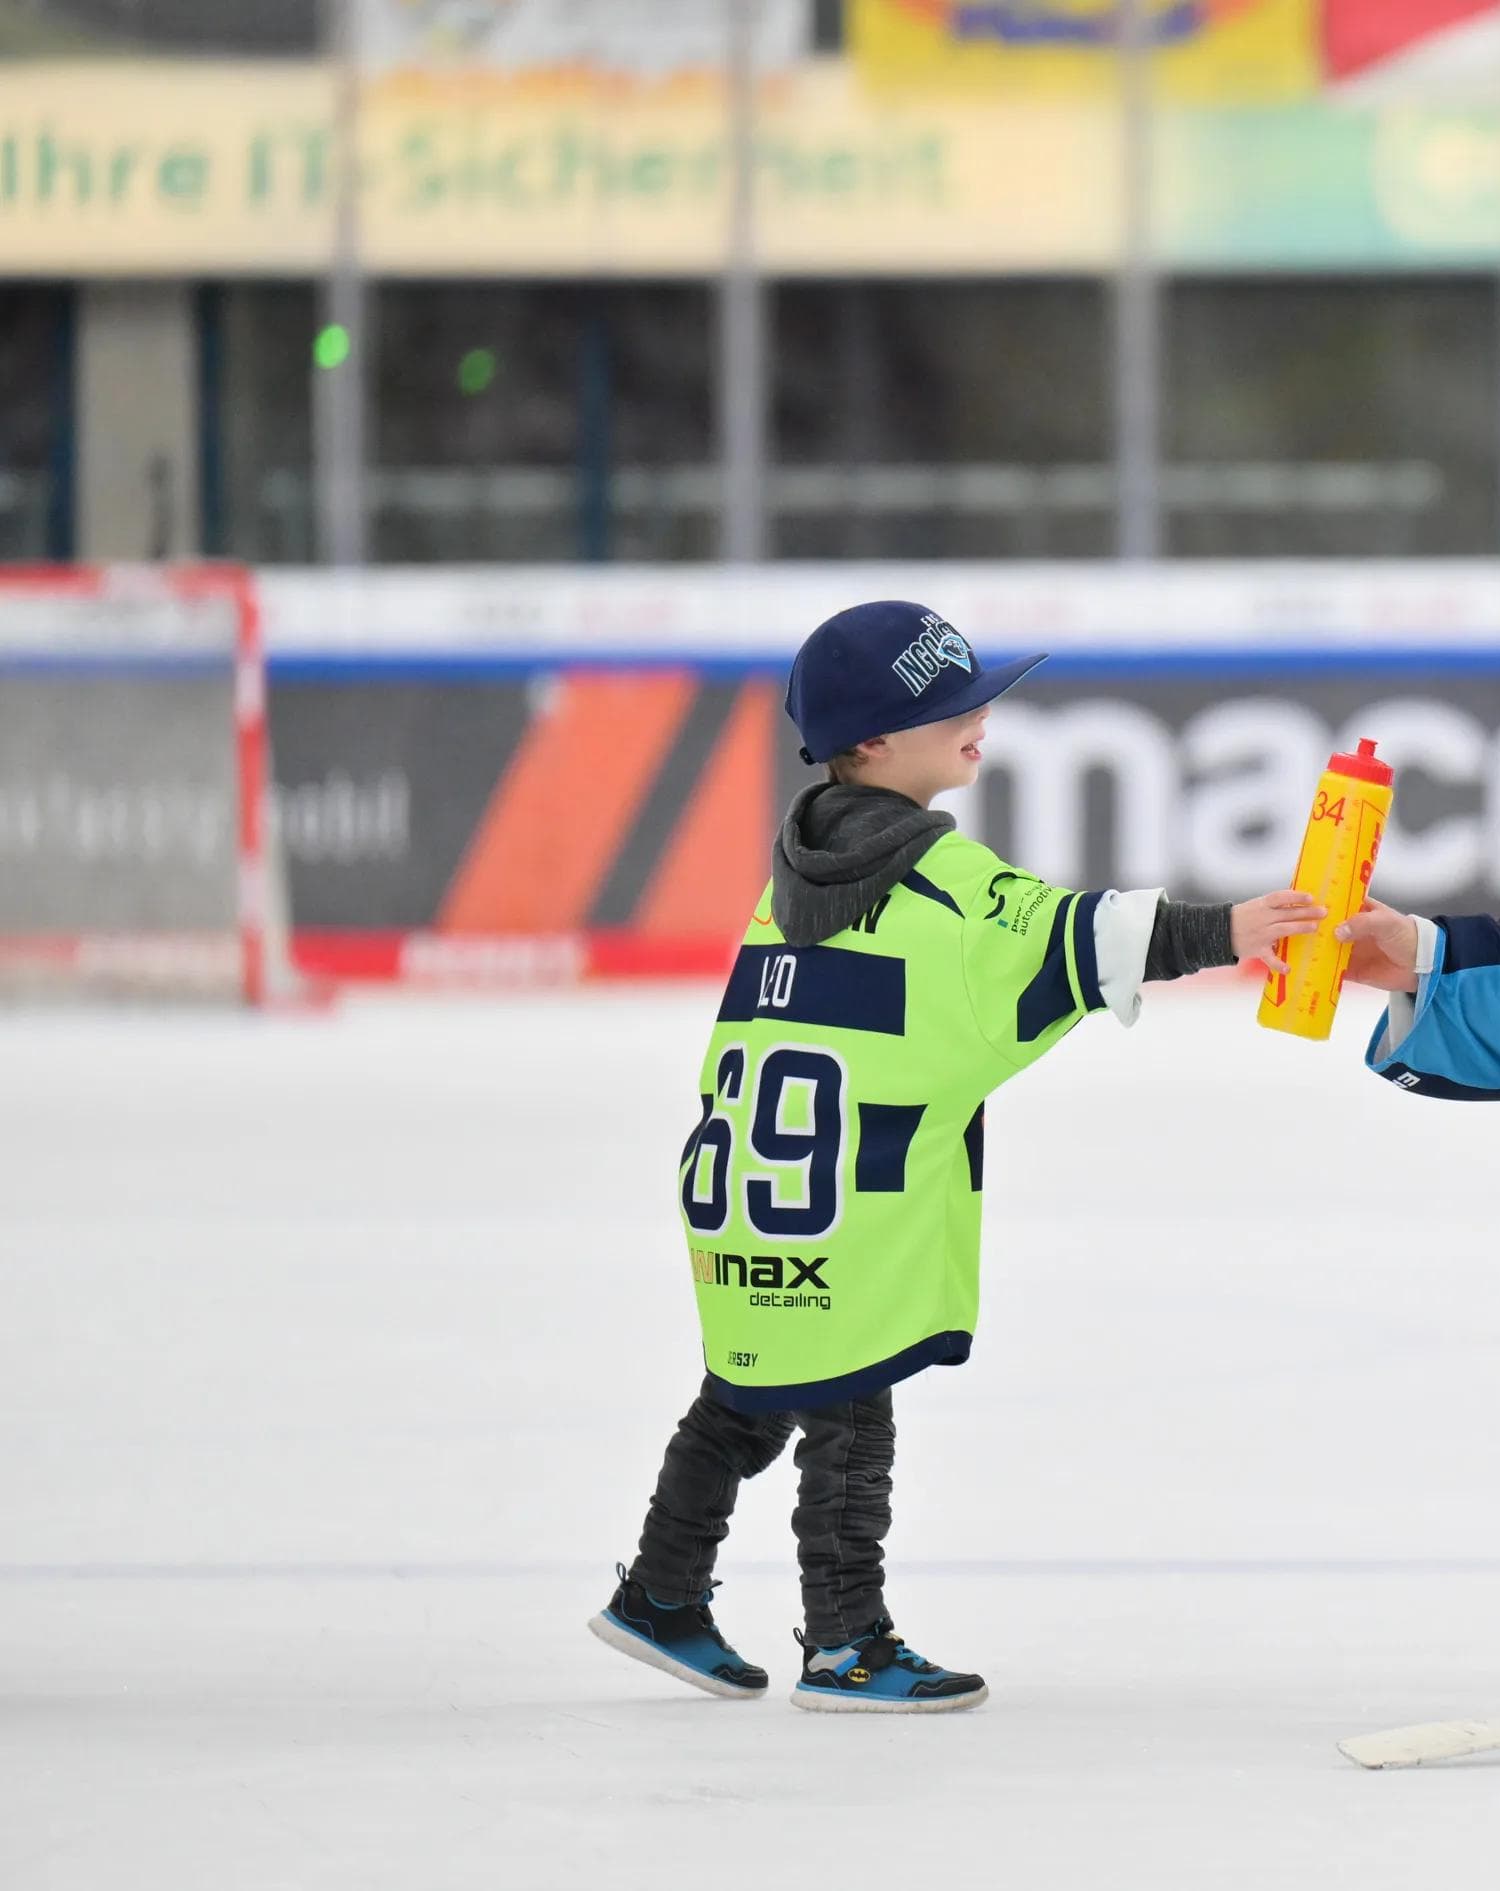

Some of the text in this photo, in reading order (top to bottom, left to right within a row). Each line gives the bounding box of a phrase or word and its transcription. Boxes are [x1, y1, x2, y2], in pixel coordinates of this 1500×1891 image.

[1312, 791, 1346, 827] 34
[1019, 885, 1053, 936] automotiv
[757, 954, 797, 1009] LO
[679, 1042, 848, 1241] 69
[749, 1292, 831, 1311] detailing
